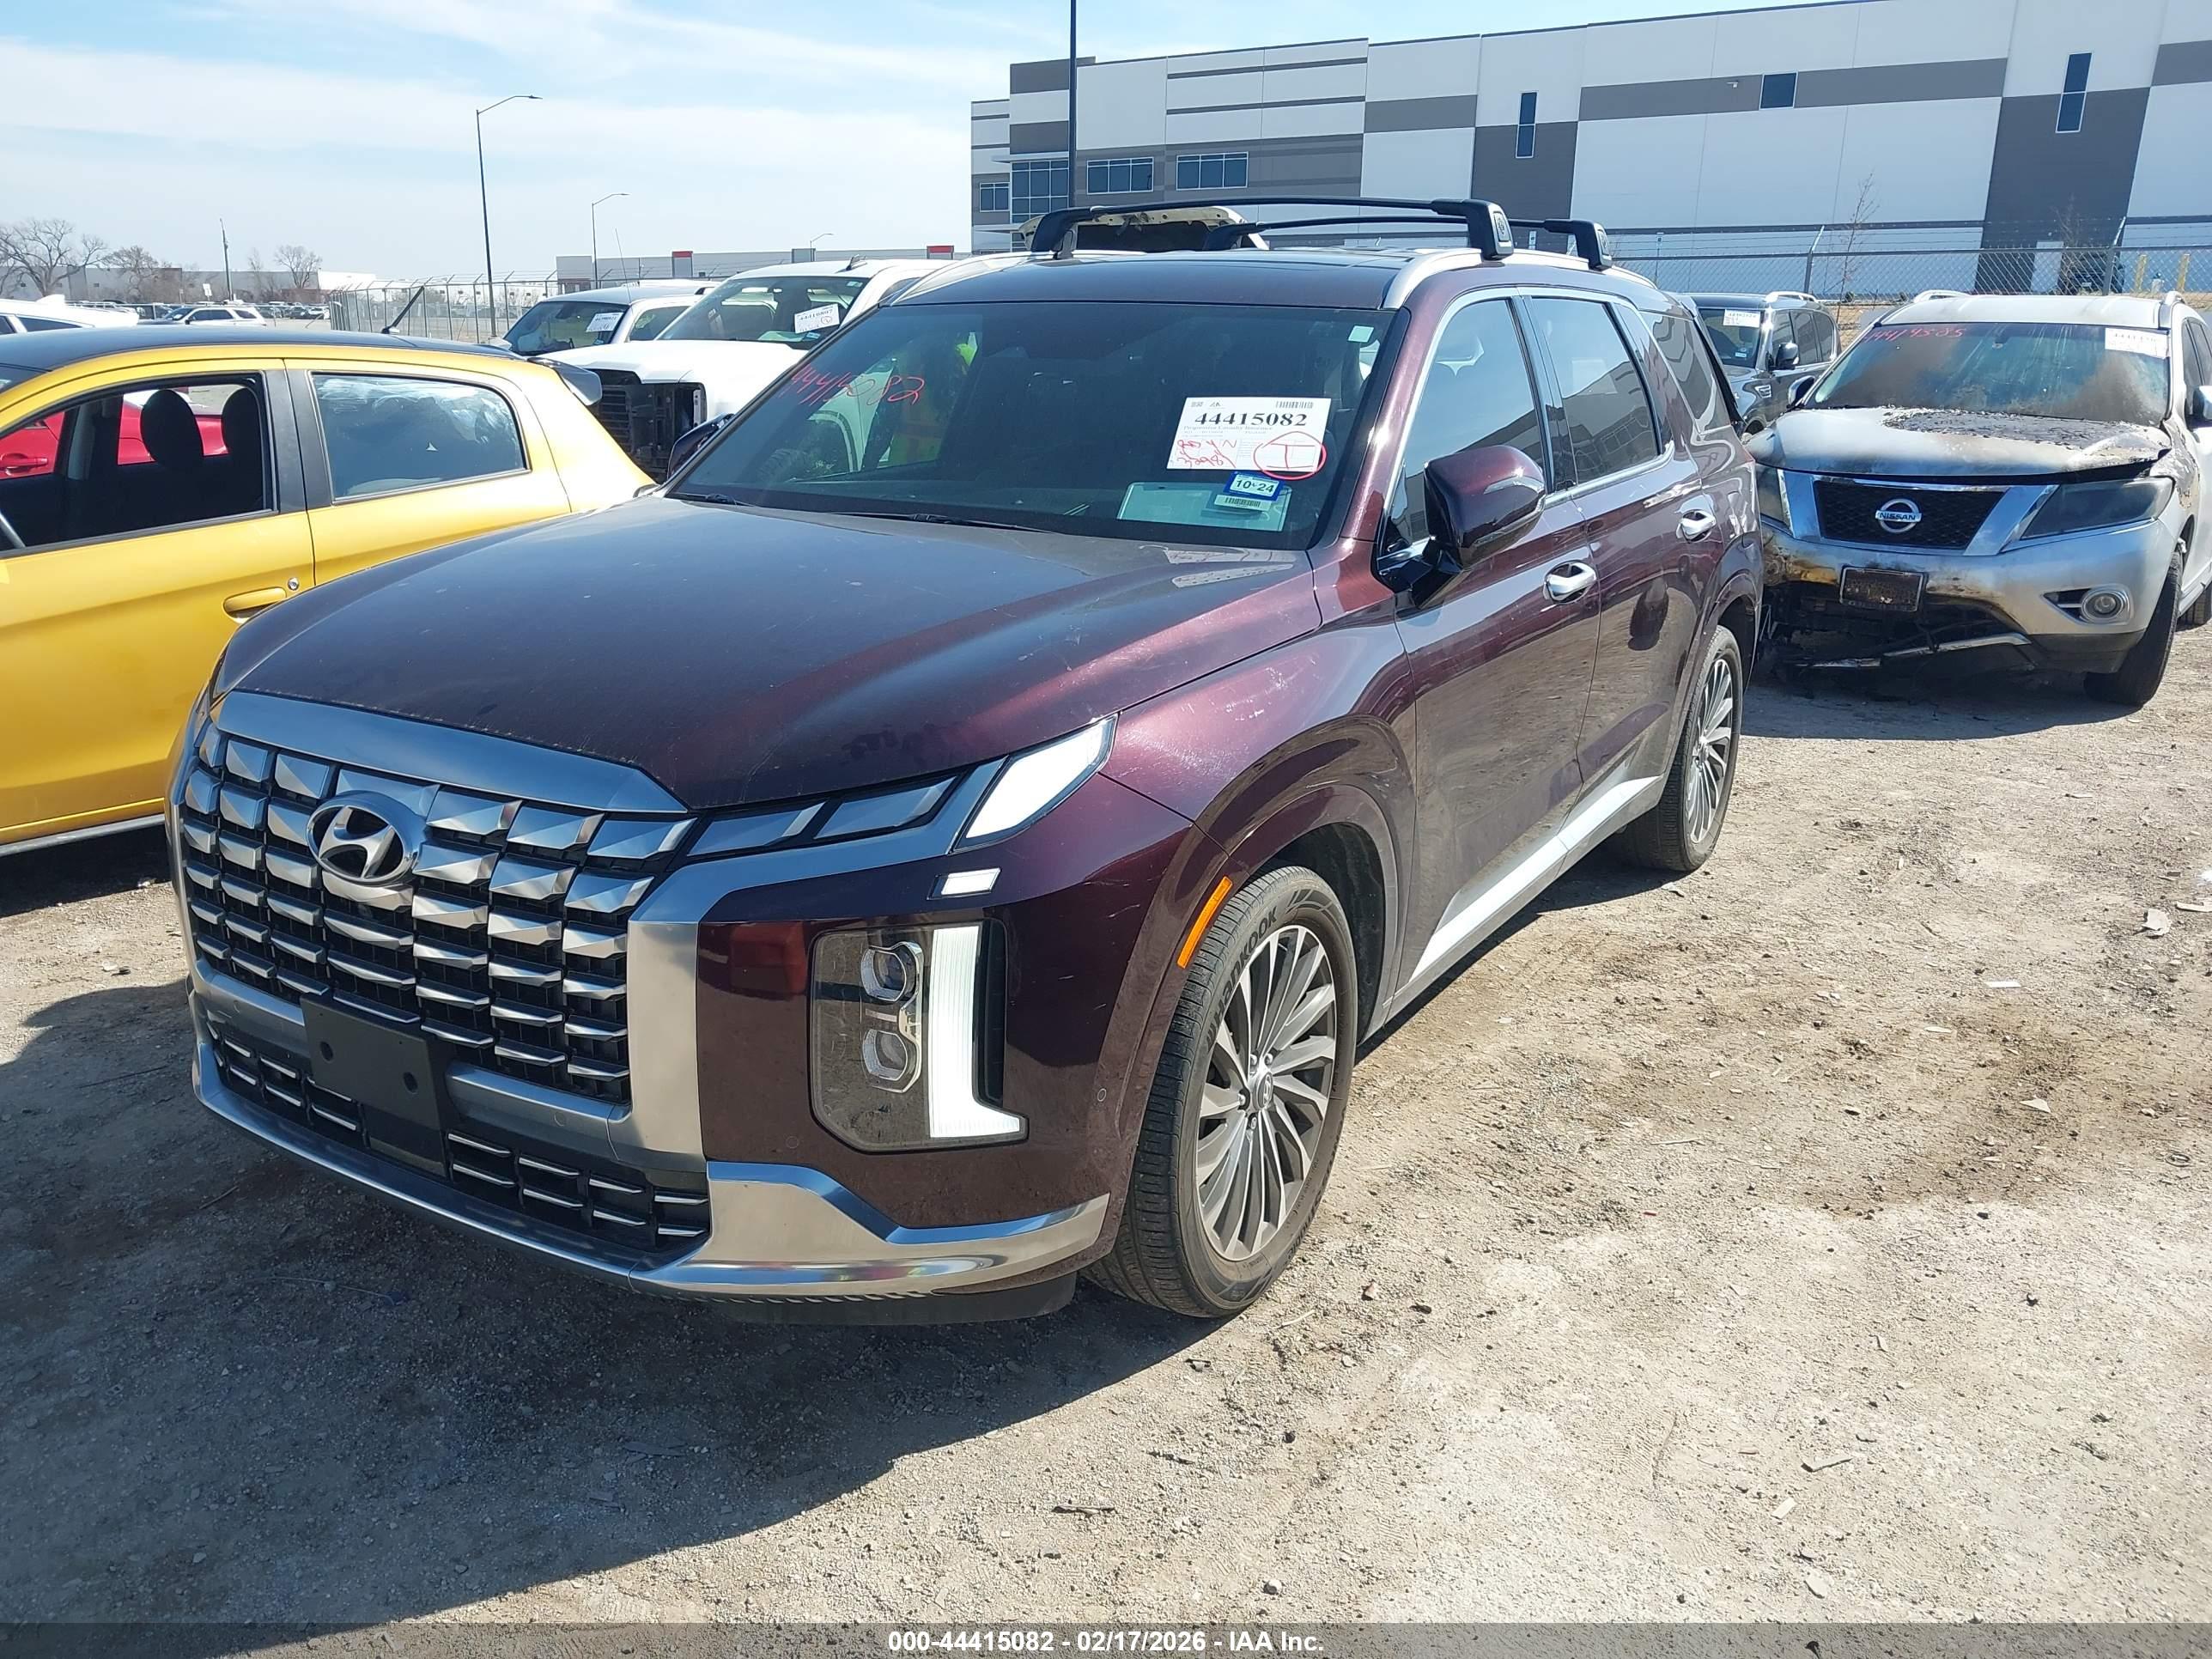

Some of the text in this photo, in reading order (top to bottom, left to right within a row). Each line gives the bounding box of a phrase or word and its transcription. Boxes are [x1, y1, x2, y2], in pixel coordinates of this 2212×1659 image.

[1194, 412, 1307, 427] 44415082
[1236, 480, 1275, 493] 10 24
